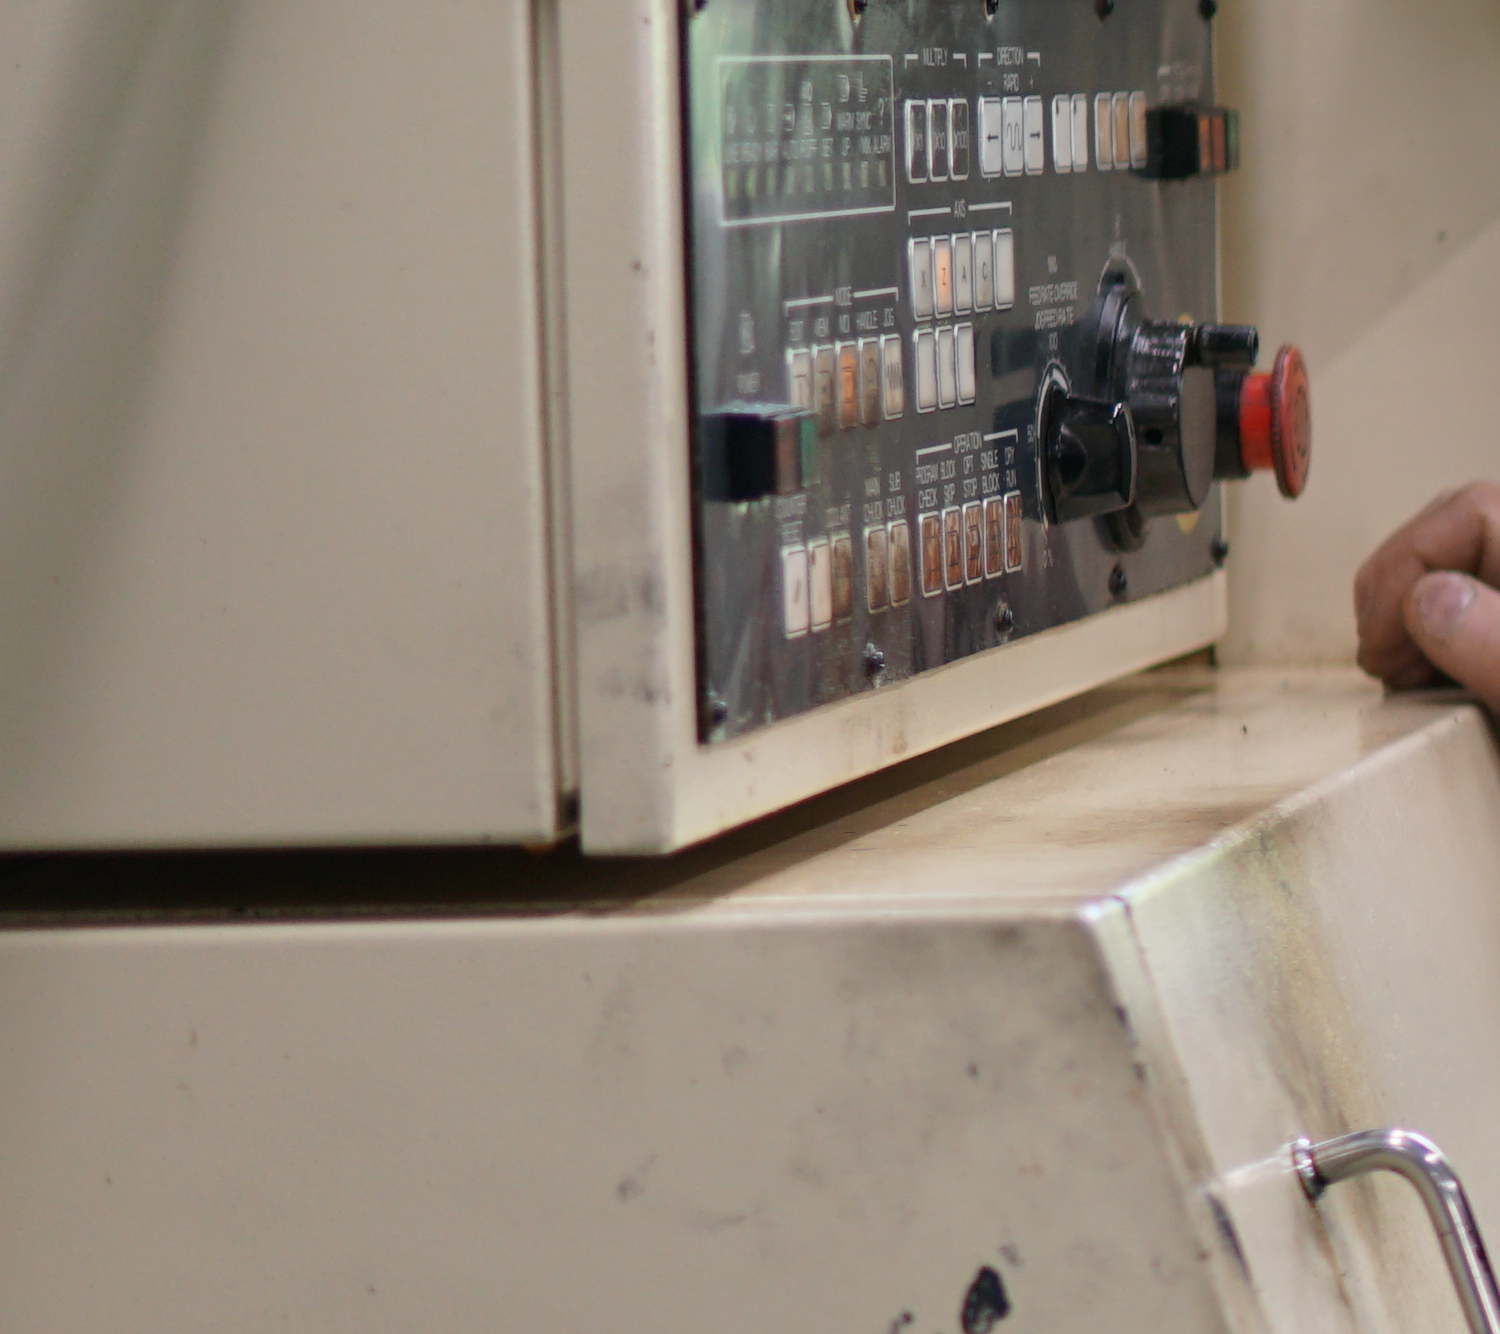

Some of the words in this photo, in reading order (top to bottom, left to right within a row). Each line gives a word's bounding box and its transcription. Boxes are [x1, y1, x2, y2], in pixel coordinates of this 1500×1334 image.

[996, 46, 1025, 66] DIRECTION
[980, 448, 1000, 472] SINGLE
[963, 477, 978, 499] STOP
[982, 472, 1000, 495] BLOCK
[918, 487, 938, 509] CHECK
